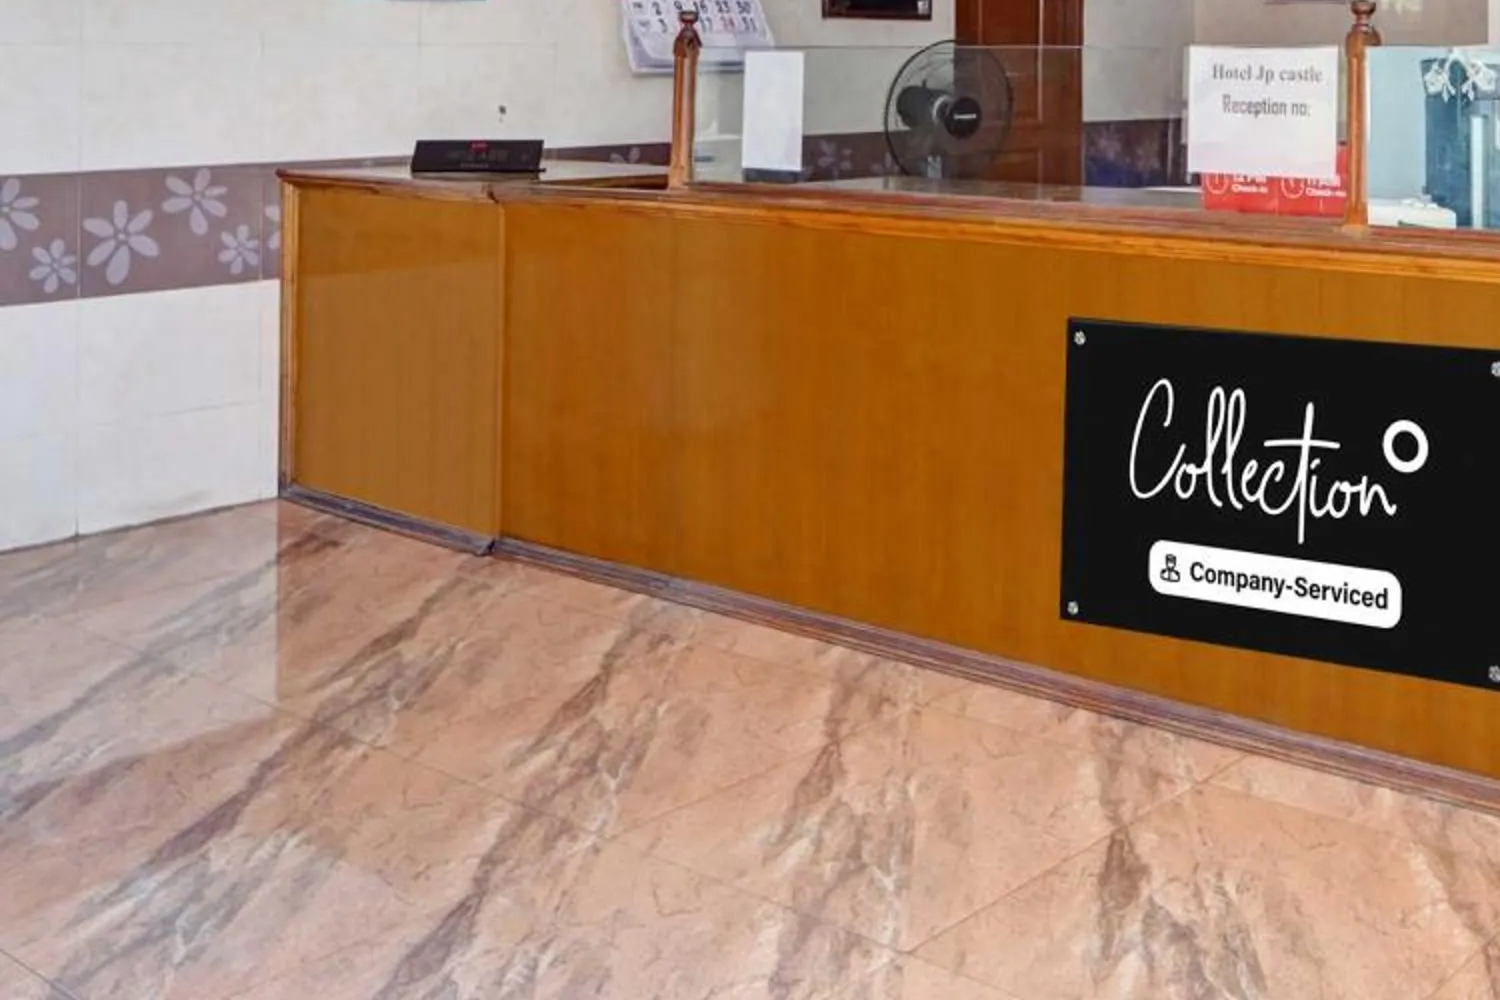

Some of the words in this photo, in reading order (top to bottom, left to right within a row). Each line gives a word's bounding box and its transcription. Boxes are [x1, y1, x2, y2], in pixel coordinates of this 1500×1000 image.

[652, 1, 661, 16] 2
[715, 1, 730, 15] 23
[736, 1, 751, 15] 30
[658, 18, 668, 34] 3
[1212, 63, 1252, 82] Hotel
[1221, 93, 1287, 118] Reception
[1128, 377, 1398, 545] Collection
[1189, 561, 1390, 611] Company-Serviced
